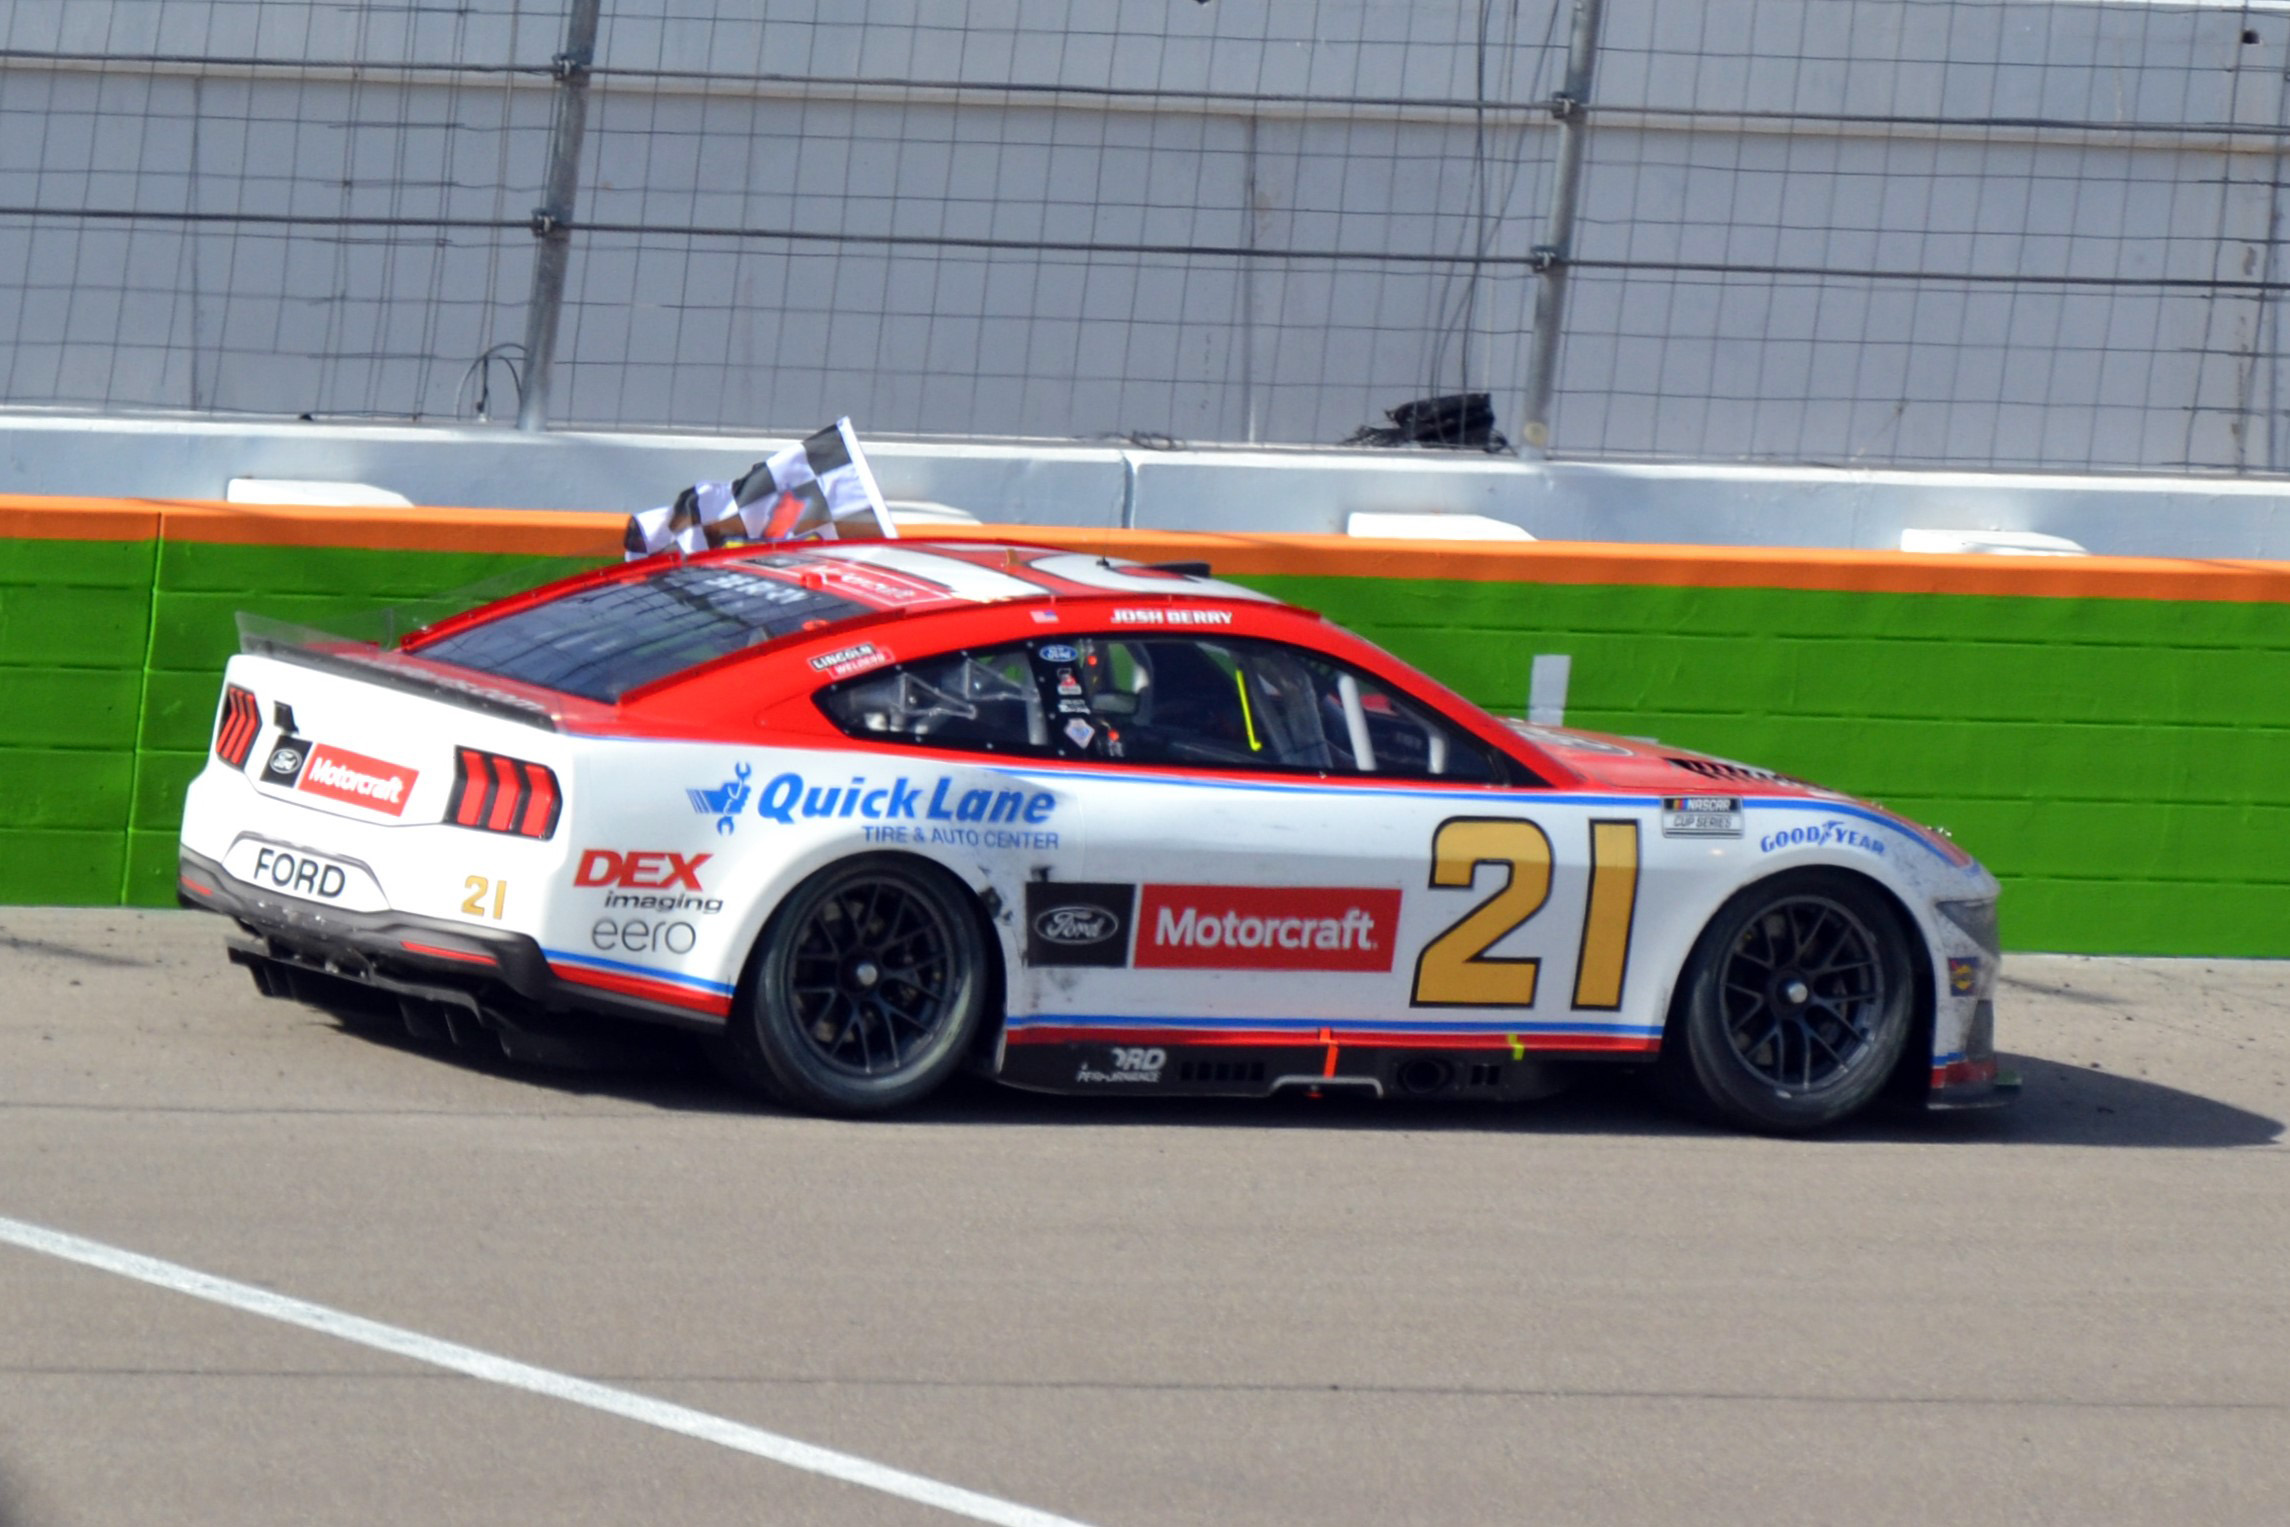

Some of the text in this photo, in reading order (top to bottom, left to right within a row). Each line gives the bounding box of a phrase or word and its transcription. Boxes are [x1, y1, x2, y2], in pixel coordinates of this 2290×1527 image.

[1110, 608, 1232, 624] JOSH BERRY
[812, 645, 873, 669] LINCOLN
[308, 757, 403, 803] Motorcraft
[757, 772, 1057, 825] Quick Lane
[1673, 813, 1732, 829] CUP SERIES
[1687, 799, 1731, 811] NASCAR
[861, 826, 1059, 850] TIRE & AUTO CENTER
[254, 847, 345, 898] FORD
[573, 849, 713, 891] DEX
[461, 875, 507, 919] 21
[604, 891, 723, 914] imaging
[1409, 816, 1640, 1010] 21
[591, 916, 697, 955] eero
[1044, 915, 1102, 942] Ford
[1155, 906, 1378, 949] Motorcraft
